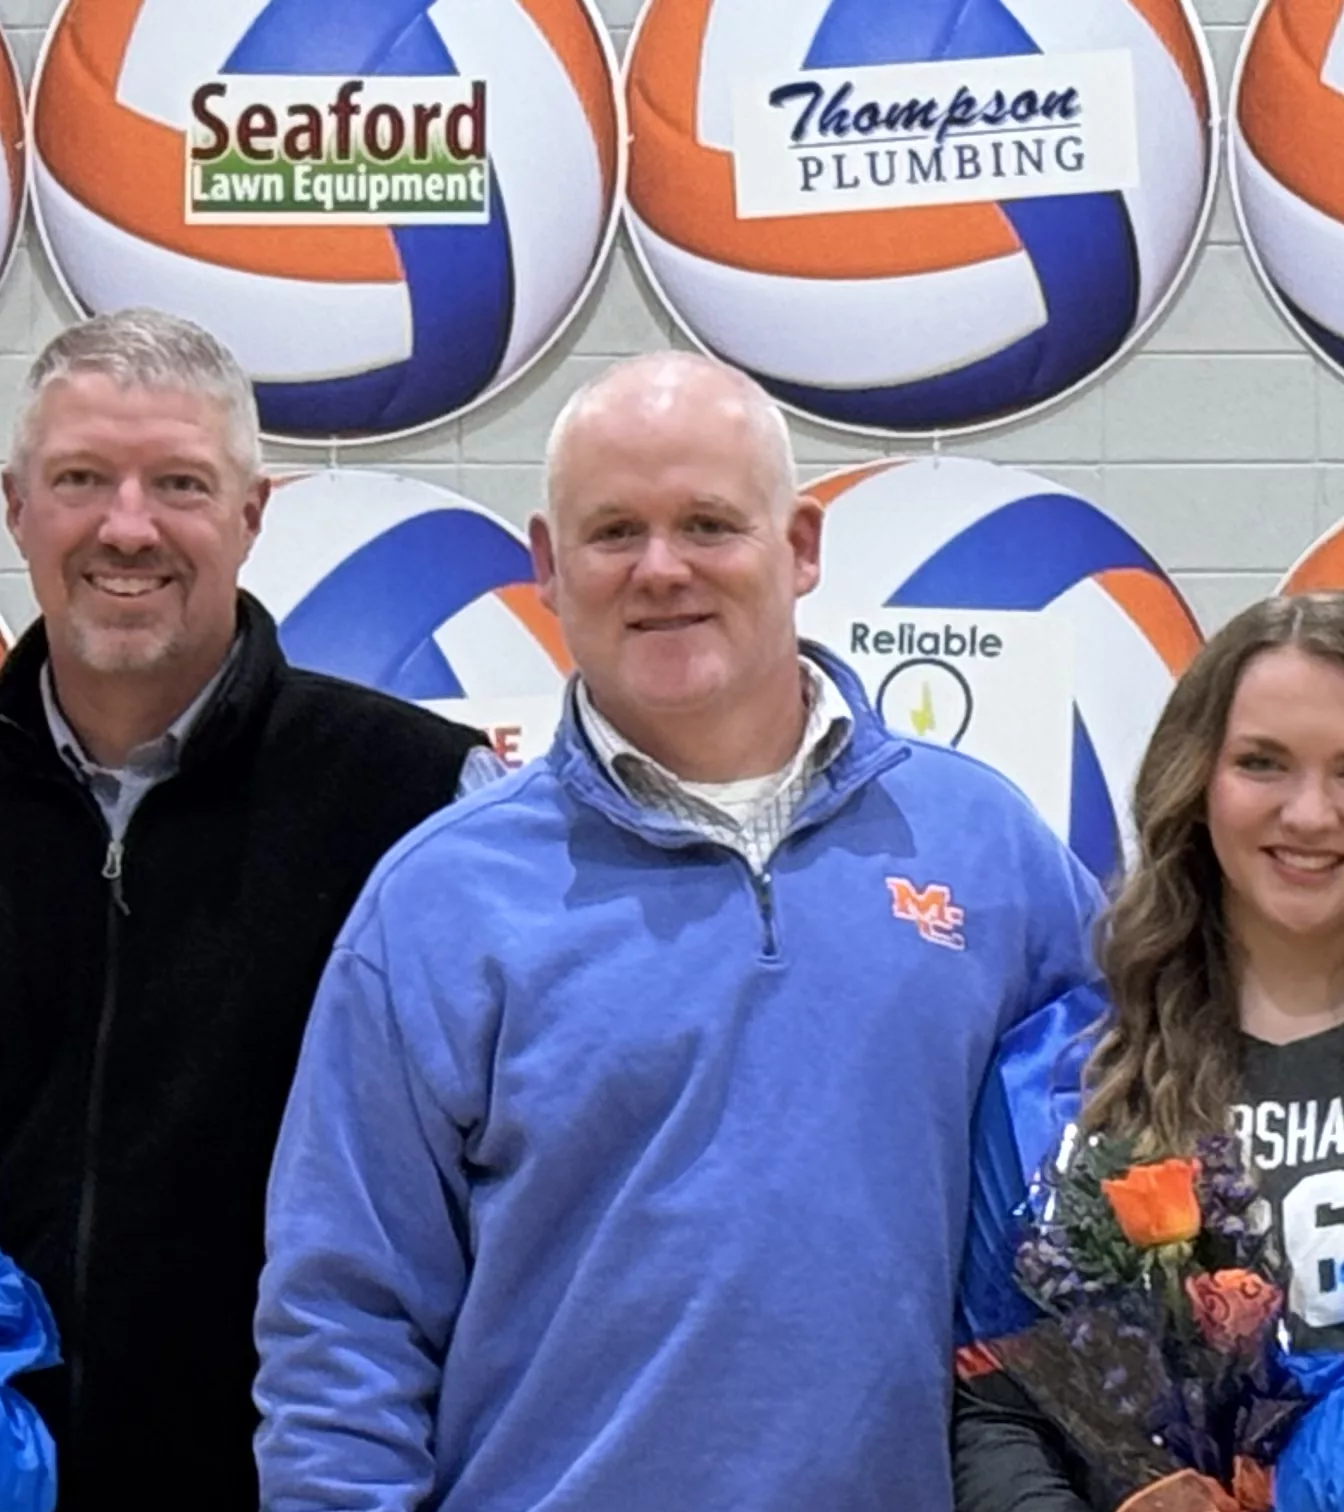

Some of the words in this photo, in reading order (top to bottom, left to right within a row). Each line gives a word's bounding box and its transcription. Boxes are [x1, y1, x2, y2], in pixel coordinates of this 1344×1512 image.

[190, 79, 487, 161] Seaford
[768, 80, 1082, 143] Thompson
[192, 163, 285, 202] Lawn
[292, 163, 485, 212] Equipment
[797, 135, 1085, 192] PLUMBING
[850, 621, 1004, 659] Reliable
